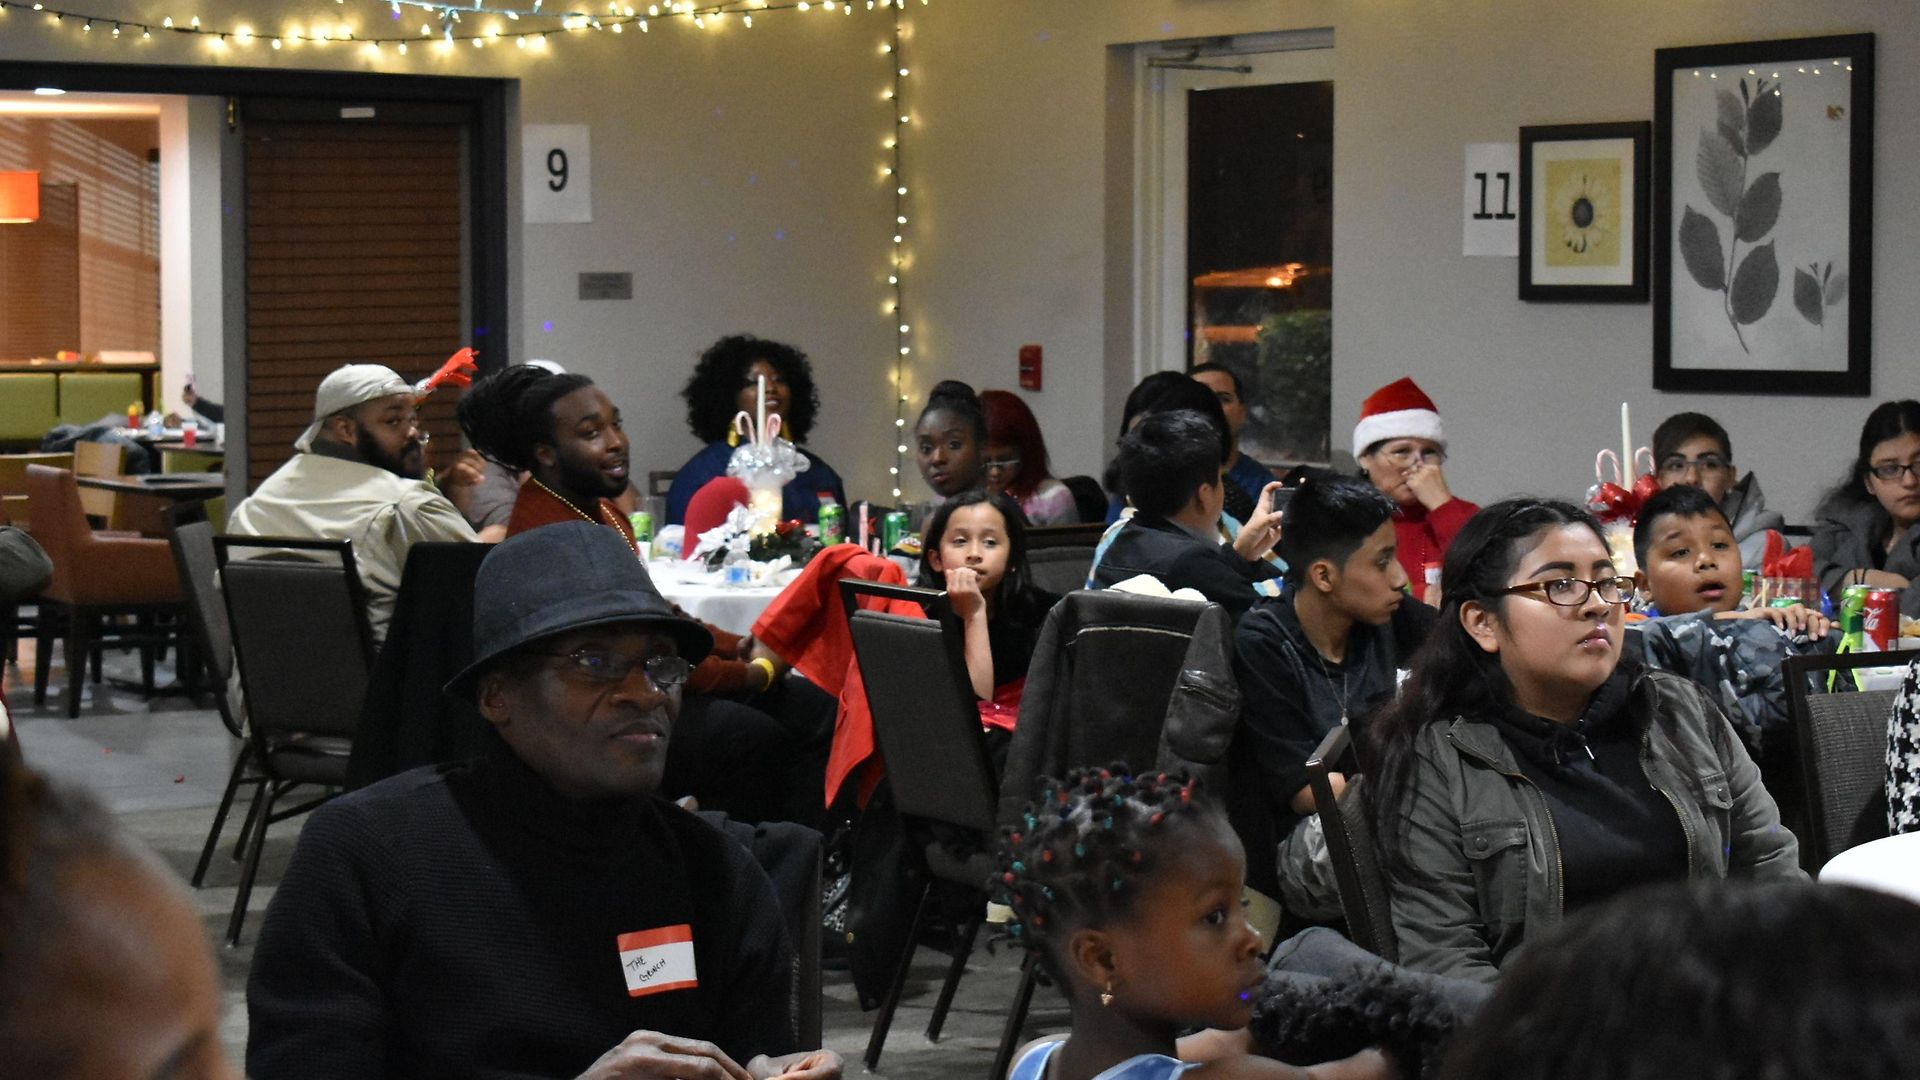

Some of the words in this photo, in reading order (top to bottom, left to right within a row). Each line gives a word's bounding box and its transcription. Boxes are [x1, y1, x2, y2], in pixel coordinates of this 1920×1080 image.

[547, 148, 569, 192] 9
[1473, 172, 1516, 220] 11
[625, 955, 647, 971] THE
